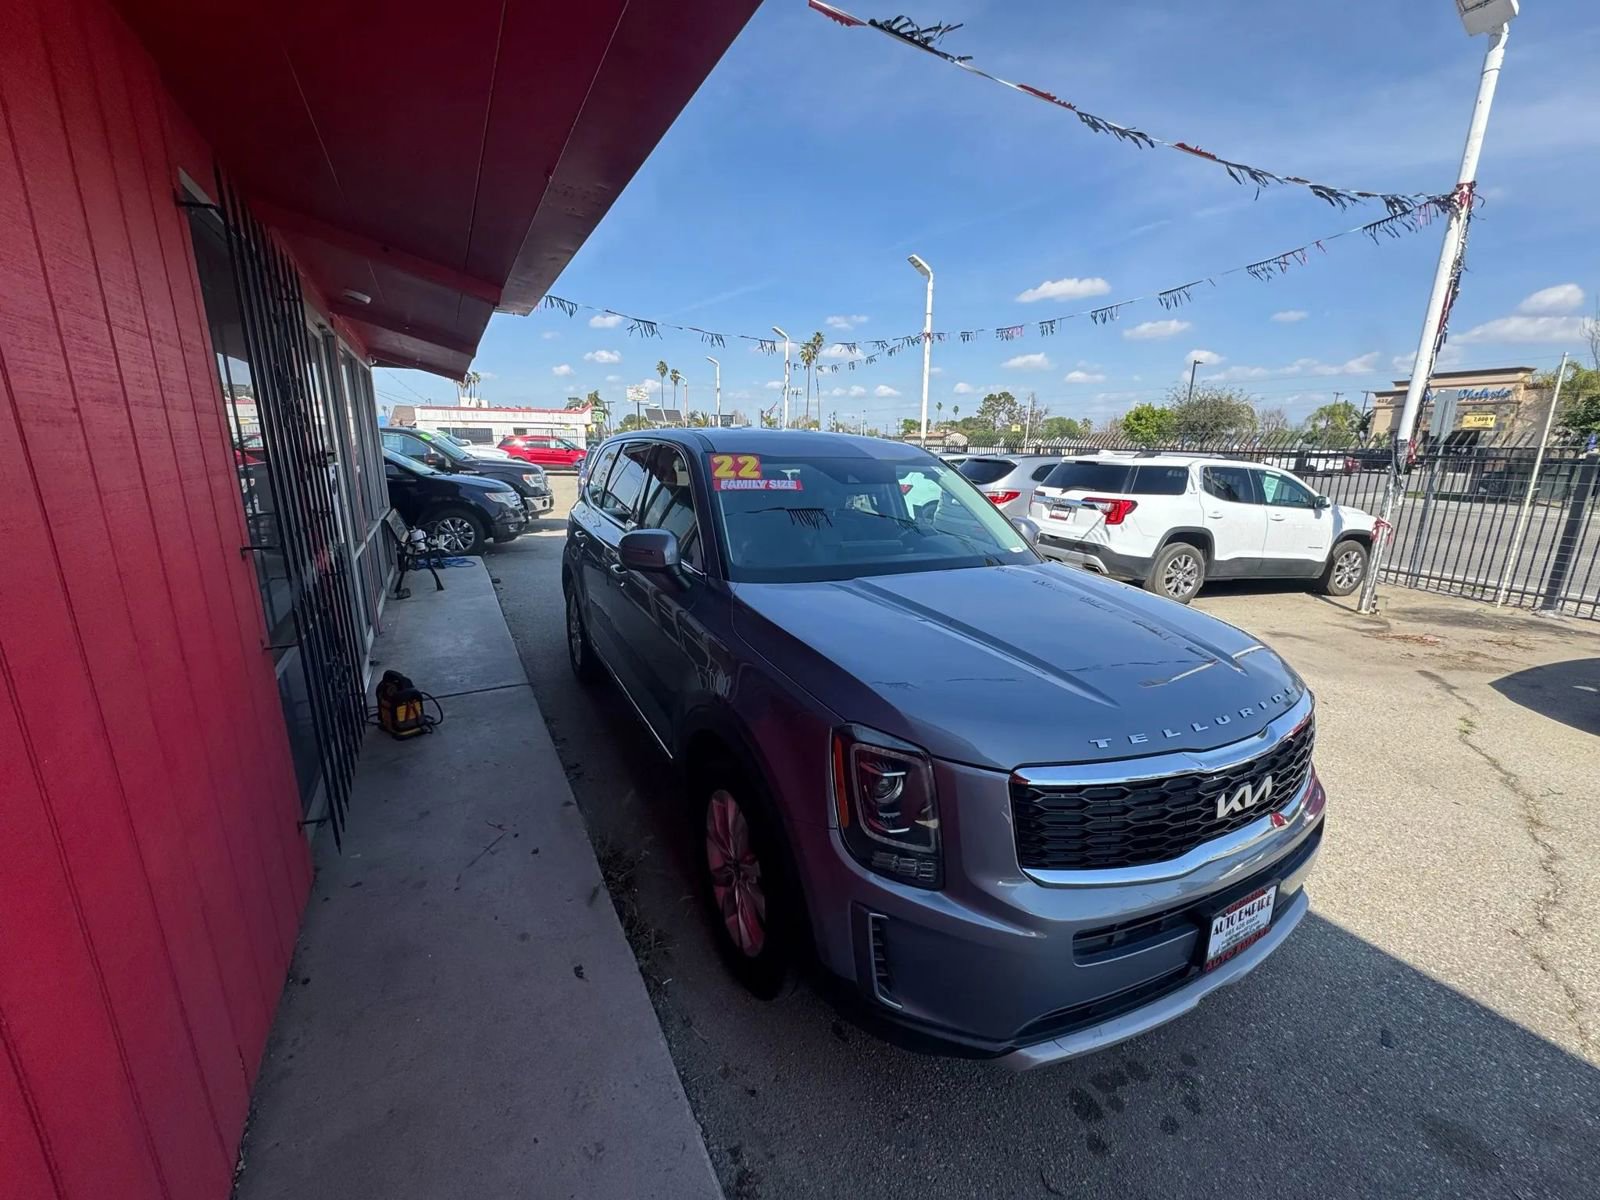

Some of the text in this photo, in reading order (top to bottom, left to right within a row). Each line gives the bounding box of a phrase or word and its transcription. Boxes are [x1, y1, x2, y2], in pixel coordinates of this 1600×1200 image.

[712, 455, 760, 479] 22
[721, 480, 797, 490] FAMILY SIZE
[1216, 775, 1272, 819] KIA
[1213, 913, 1237, 935] AUTO
